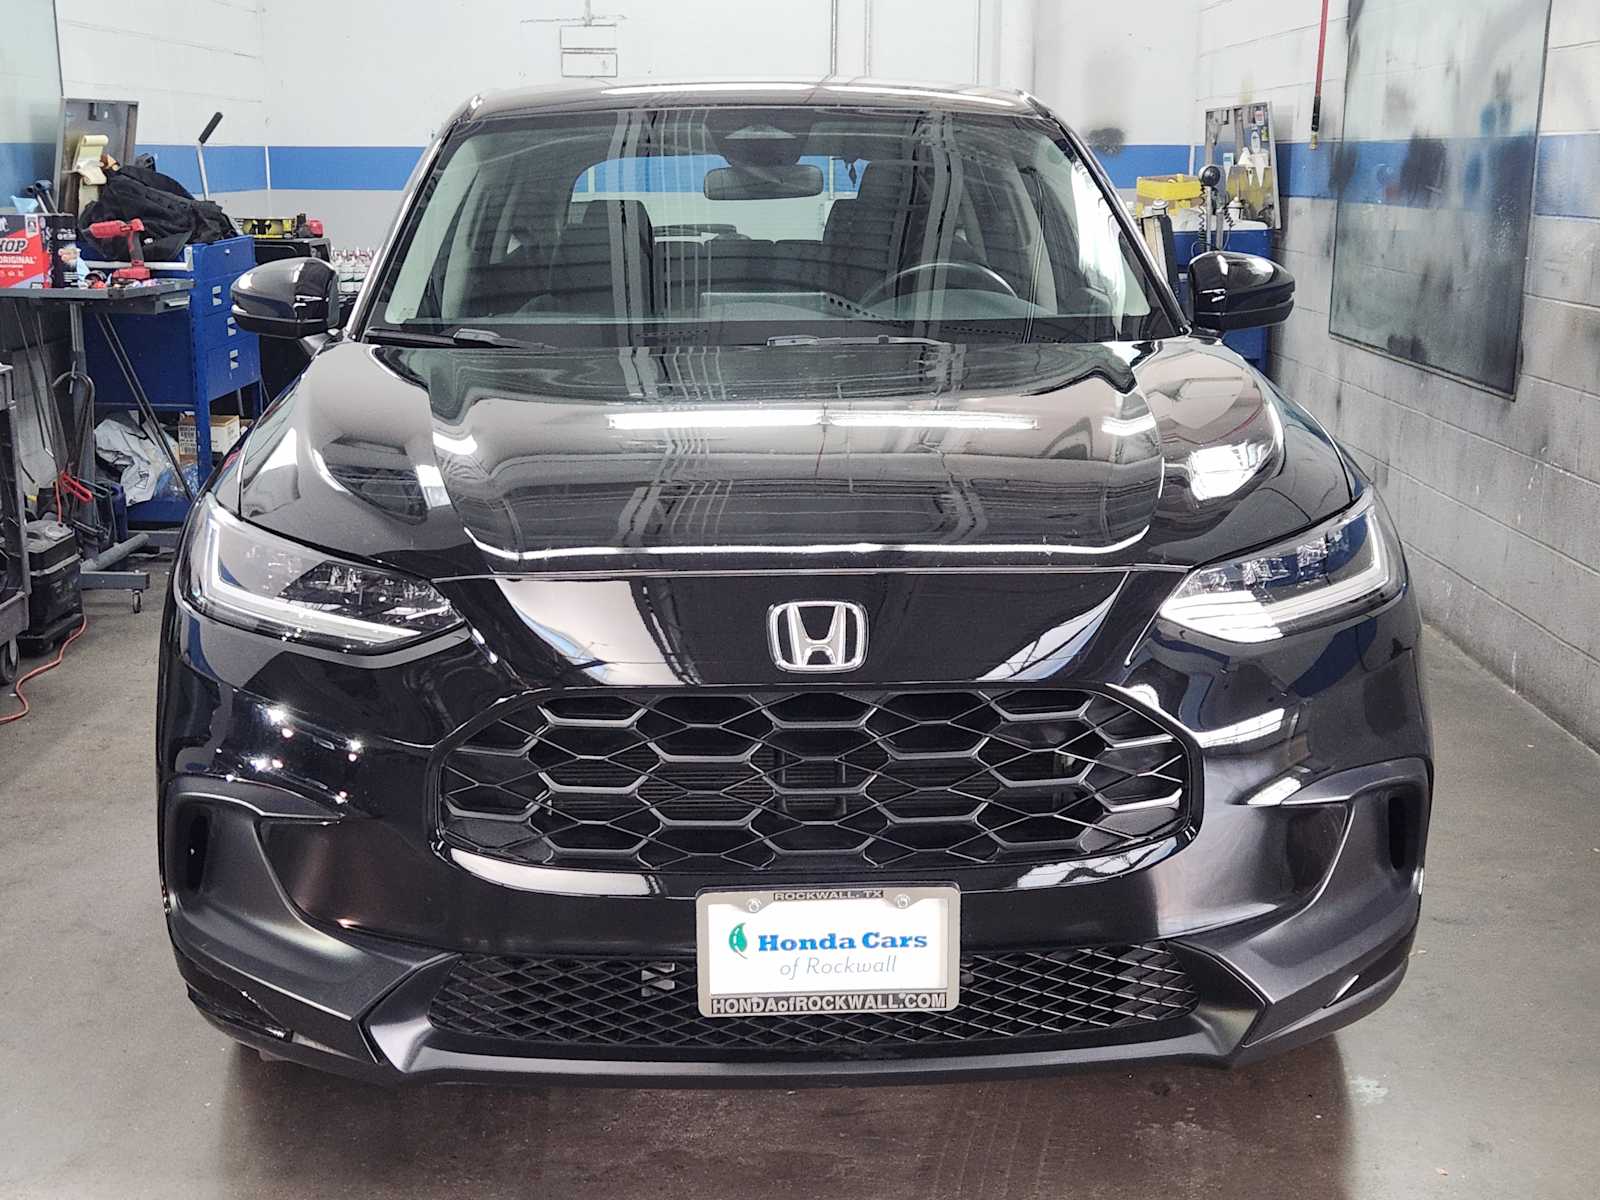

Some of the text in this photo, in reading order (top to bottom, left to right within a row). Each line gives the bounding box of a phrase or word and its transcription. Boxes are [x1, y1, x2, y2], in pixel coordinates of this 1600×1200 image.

[863, 890, 882, 899] TX
[758, 931, 927, 952] Honda Cars
[779, 955, 896, 980] of Rockwall
[712, 994, 946, 1014] HONDAofROCKWALL.COM
